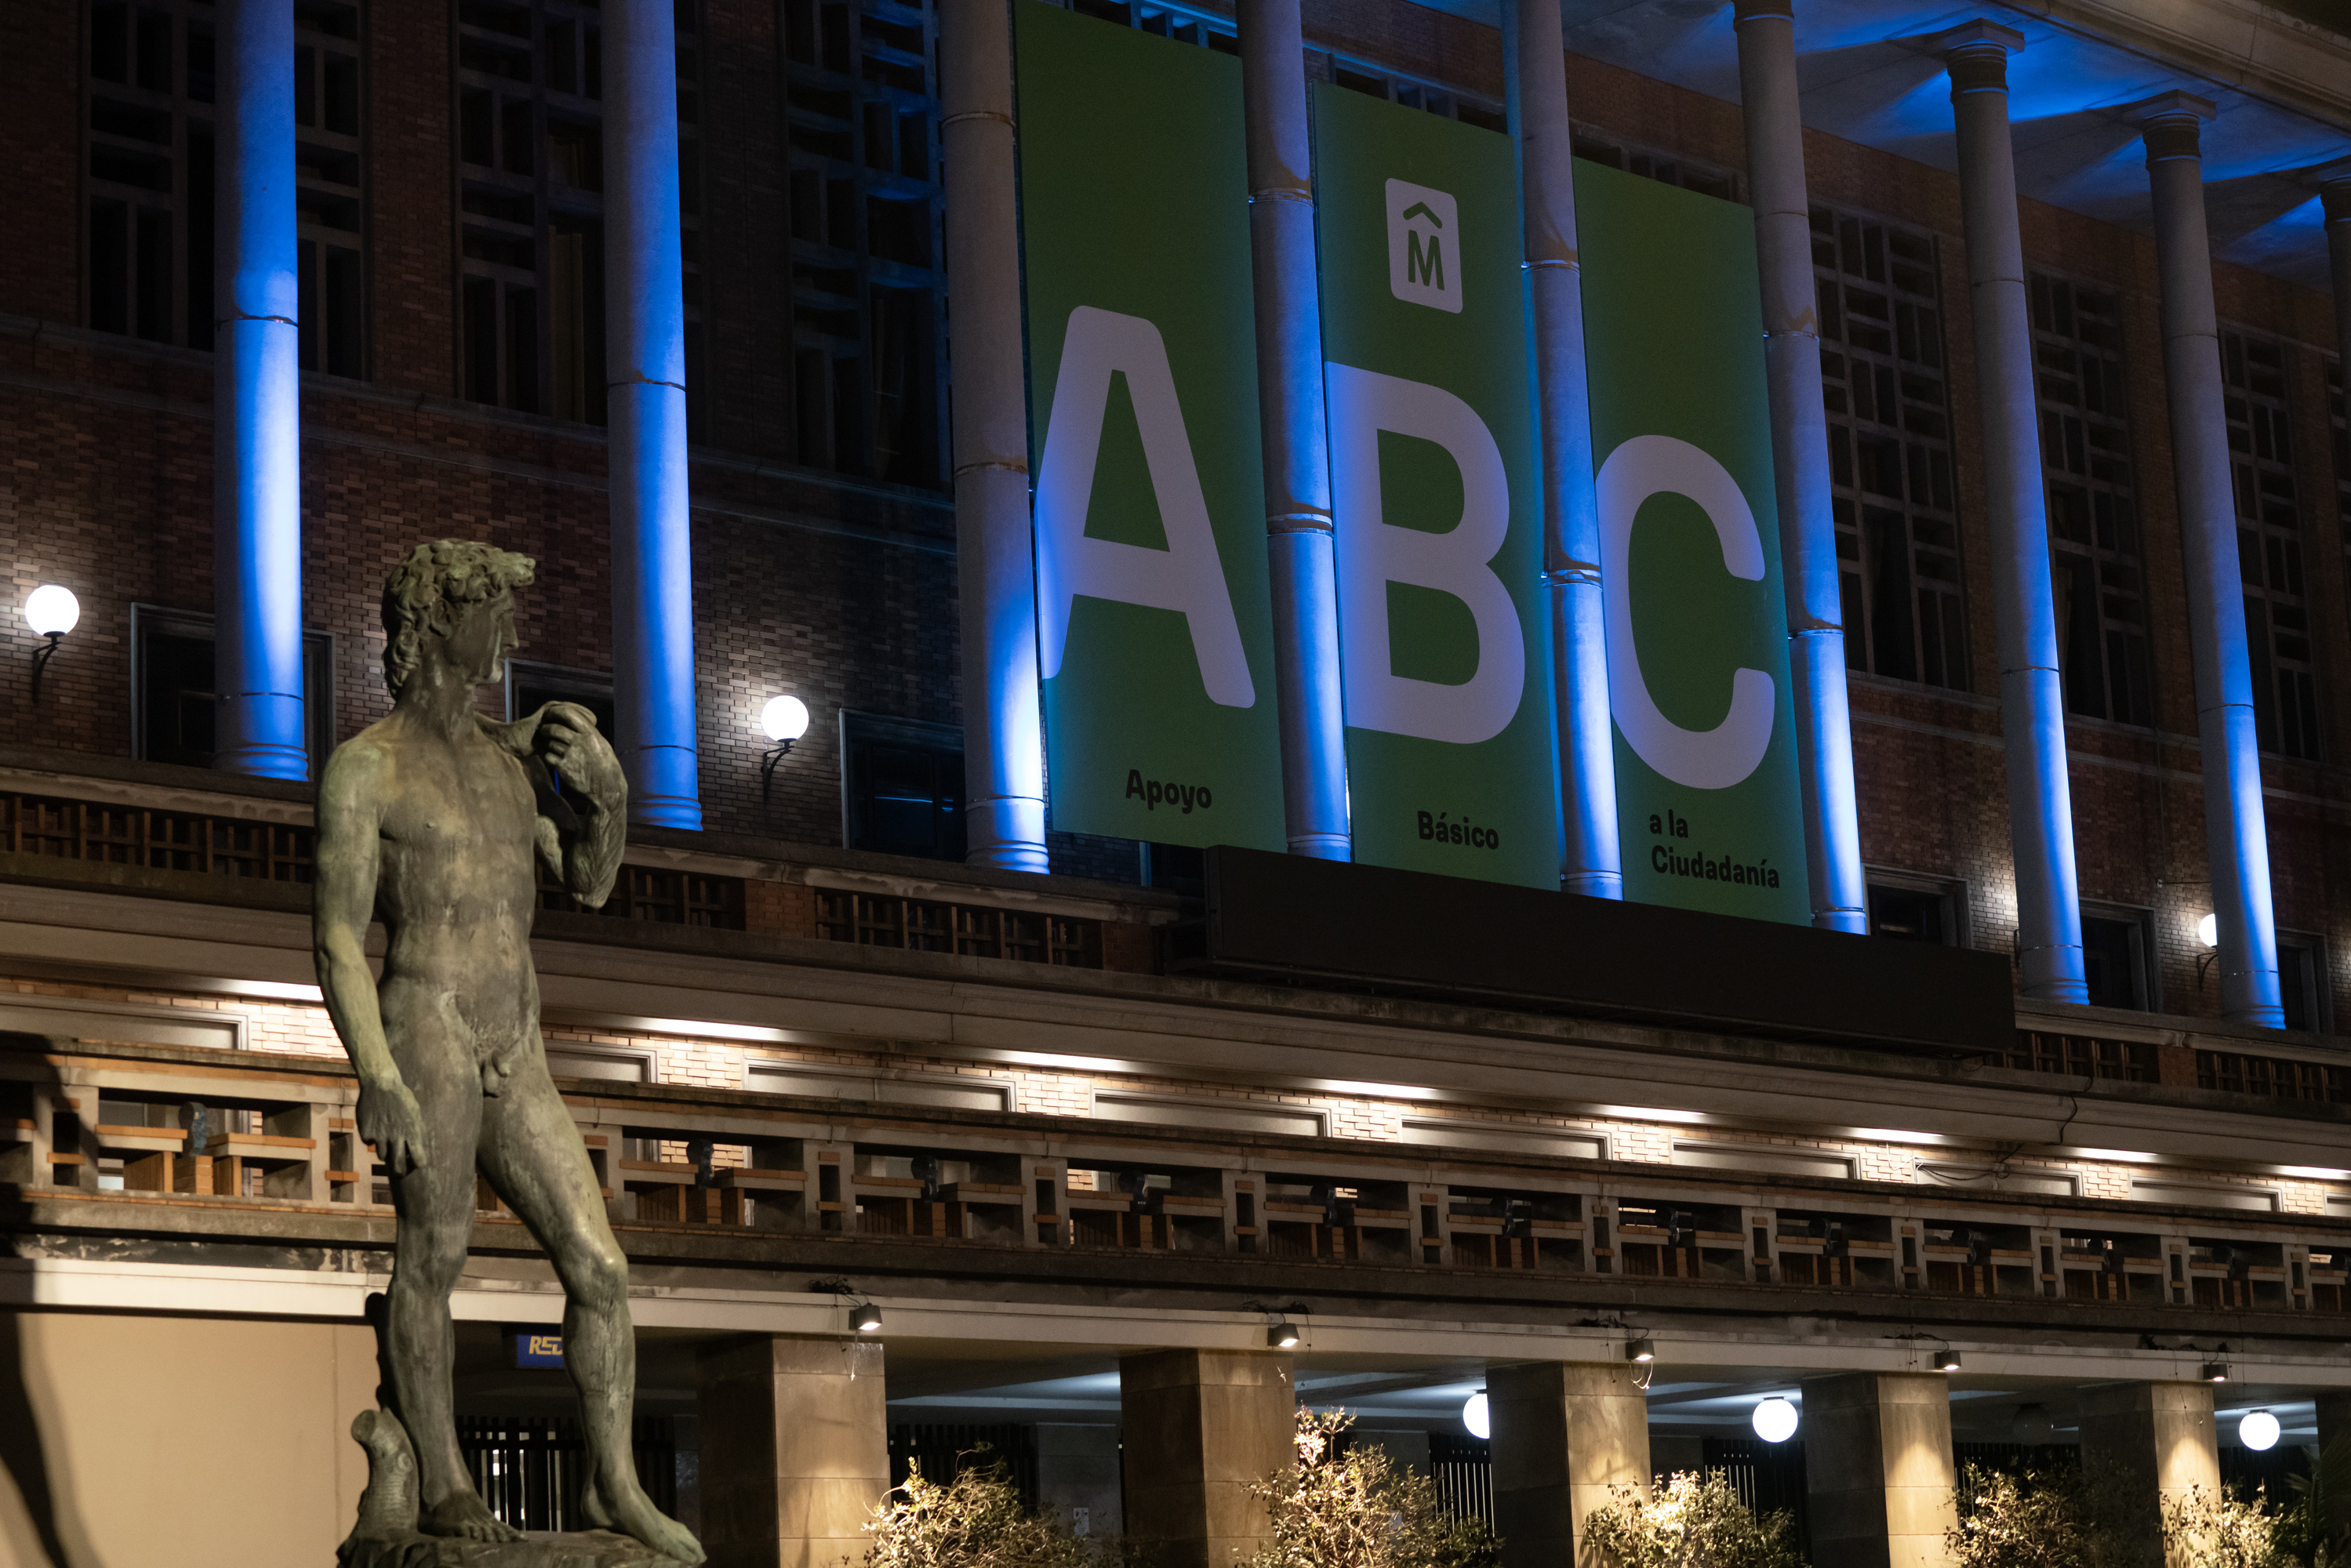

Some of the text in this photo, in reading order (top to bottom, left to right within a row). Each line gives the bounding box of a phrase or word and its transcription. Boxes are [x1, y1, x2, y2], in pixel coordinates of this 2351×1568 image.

[1408, 229, 1445, 291] M
[1125, 768, 1212, 815] Apoyo
[1417, 810, 1499, 850] Básico
[1649, 809, 1689, 839] a la
[1652, 844, 1779, 888] Ciudadanía
